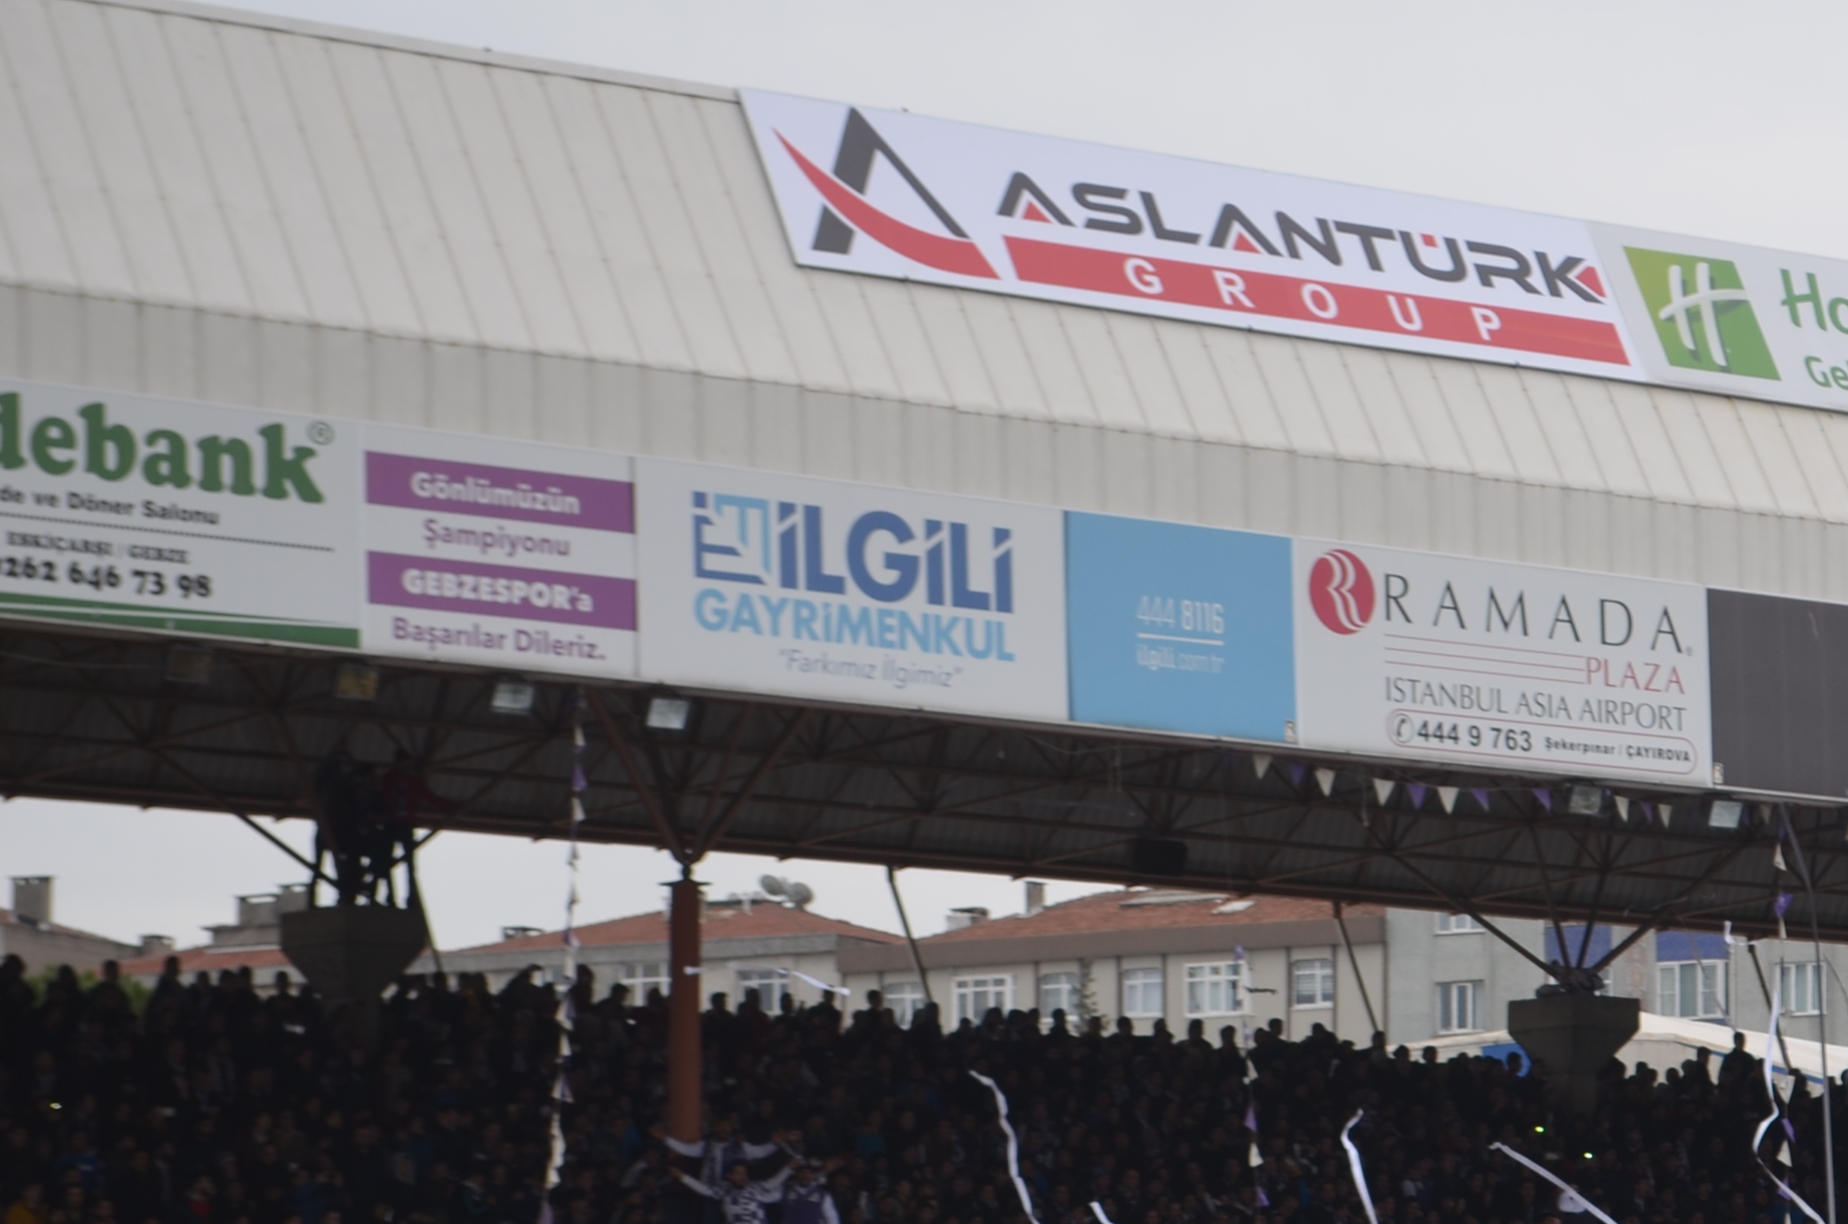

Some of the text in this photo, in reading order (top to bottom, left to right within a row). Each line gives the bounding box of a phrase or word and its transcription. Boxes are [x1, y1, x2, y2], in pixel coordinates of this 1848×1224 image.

[997, 172, 1609, 305] ASLANTÜRK
[1125, 256, 1502, 341] GROUP
[142, 500, 220, 525] Salonu
[410, 471, 581, 515] Gönlümüzün
[422, 518, 571, 558] Şampiyonu
[0, 556, 212, 598] 262 646 73 98
[391, 616, 507, 651] Başarılar
[692, 588, 1016, 662] GAYRİMENKUL
[1136, 595, 1225, 634] 444 8116
[1383, 573, 1683, 654] RAMADA
[1584, 656, 1685, 695] PLAZA
[1385, 676, 1688, 731] ISTANBUL ASIA AIRPORT
[1417, 720, 1461, 746] 444
[1468, 725, 1482, 747] 9
[1490, 727, 1533, 752] 763
[1625, 744, 1691, 763] ÇAYIROVA
